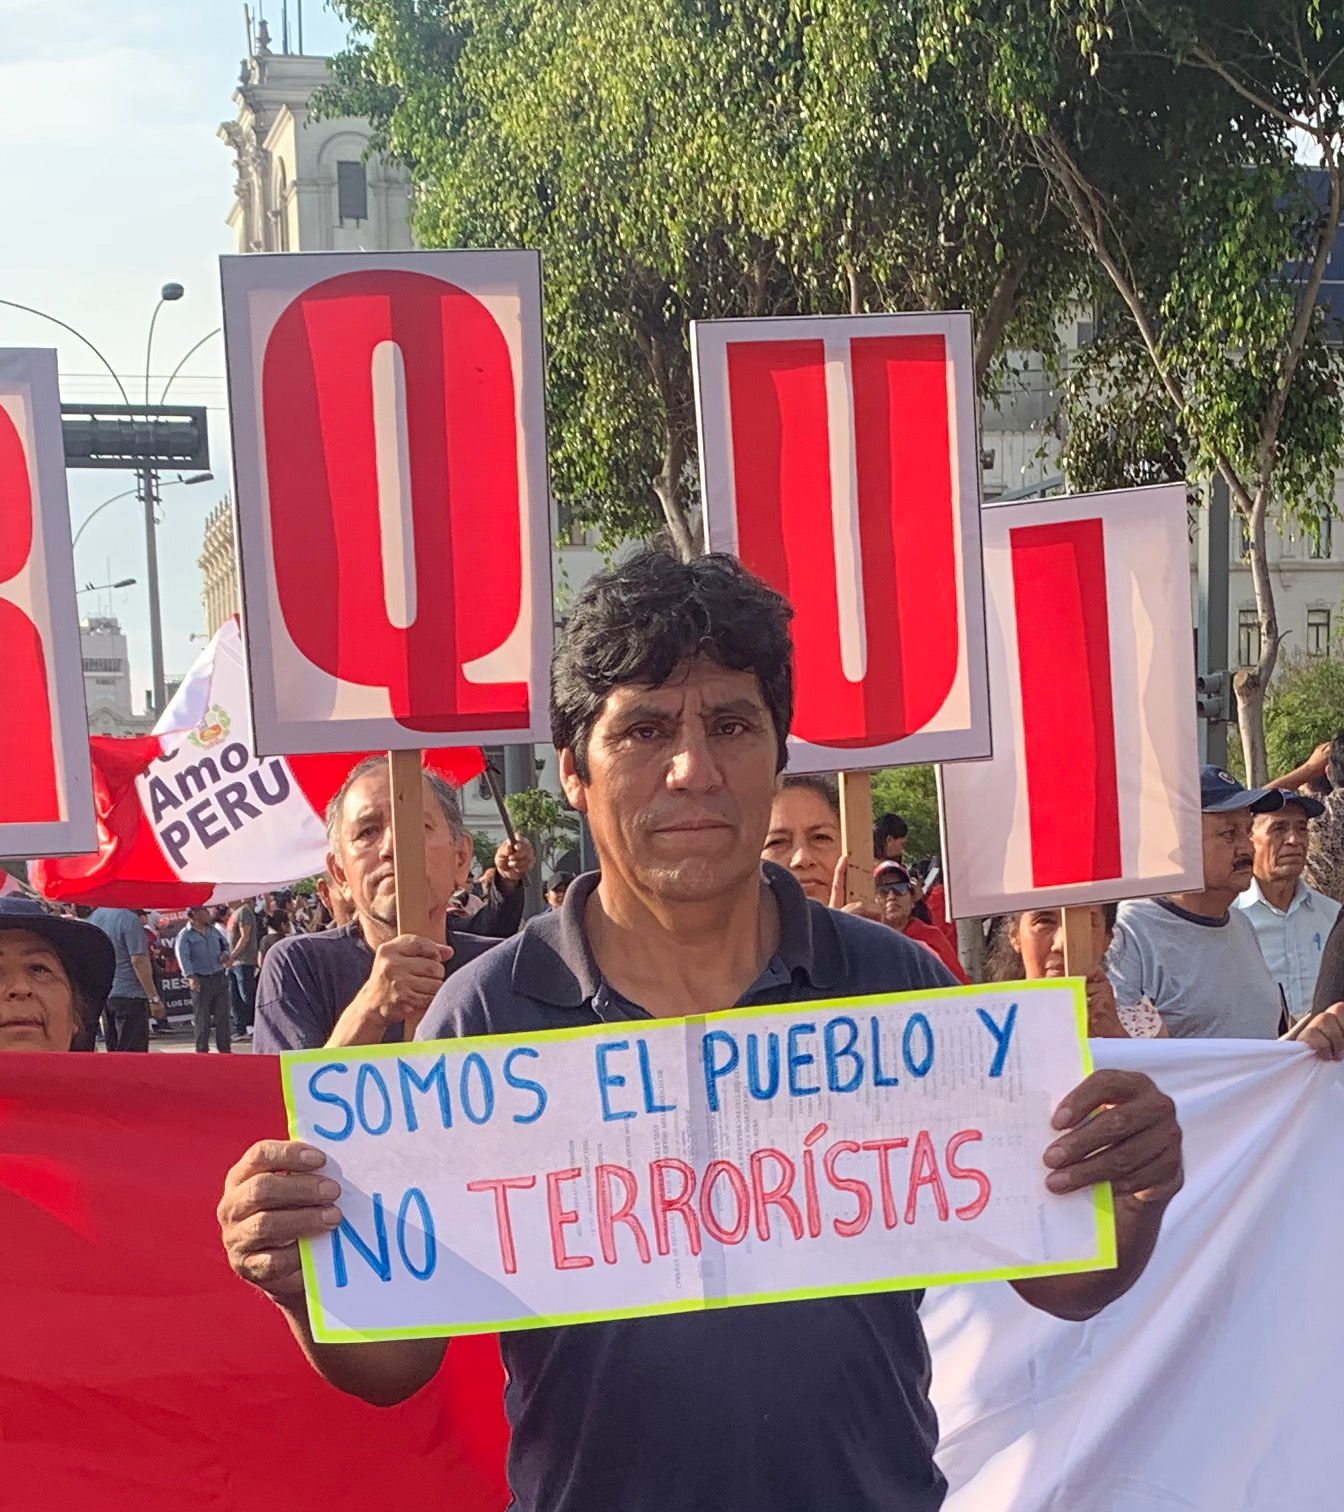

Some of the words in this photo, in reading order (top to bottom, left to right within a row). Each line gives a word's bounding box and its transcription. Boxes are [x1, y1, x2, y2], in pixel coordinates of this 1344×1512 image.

[262, 269, 529, 730] Q
[726, 334, 958, 748] U
[148, 742, 249, 826] Amo
[1010, 518, 1122, 888] I
[307, 1047, 548, 1142] SOMOS
[596, 1040, 677, 1122] EL
[702, 1013, 934, 1112] PUEBLO
[974, 1003, 1019, 1078] Y
[330, 1186, 437, 1289] NO
[467, 1122, 992, 1275] TERRORÍSTAS
